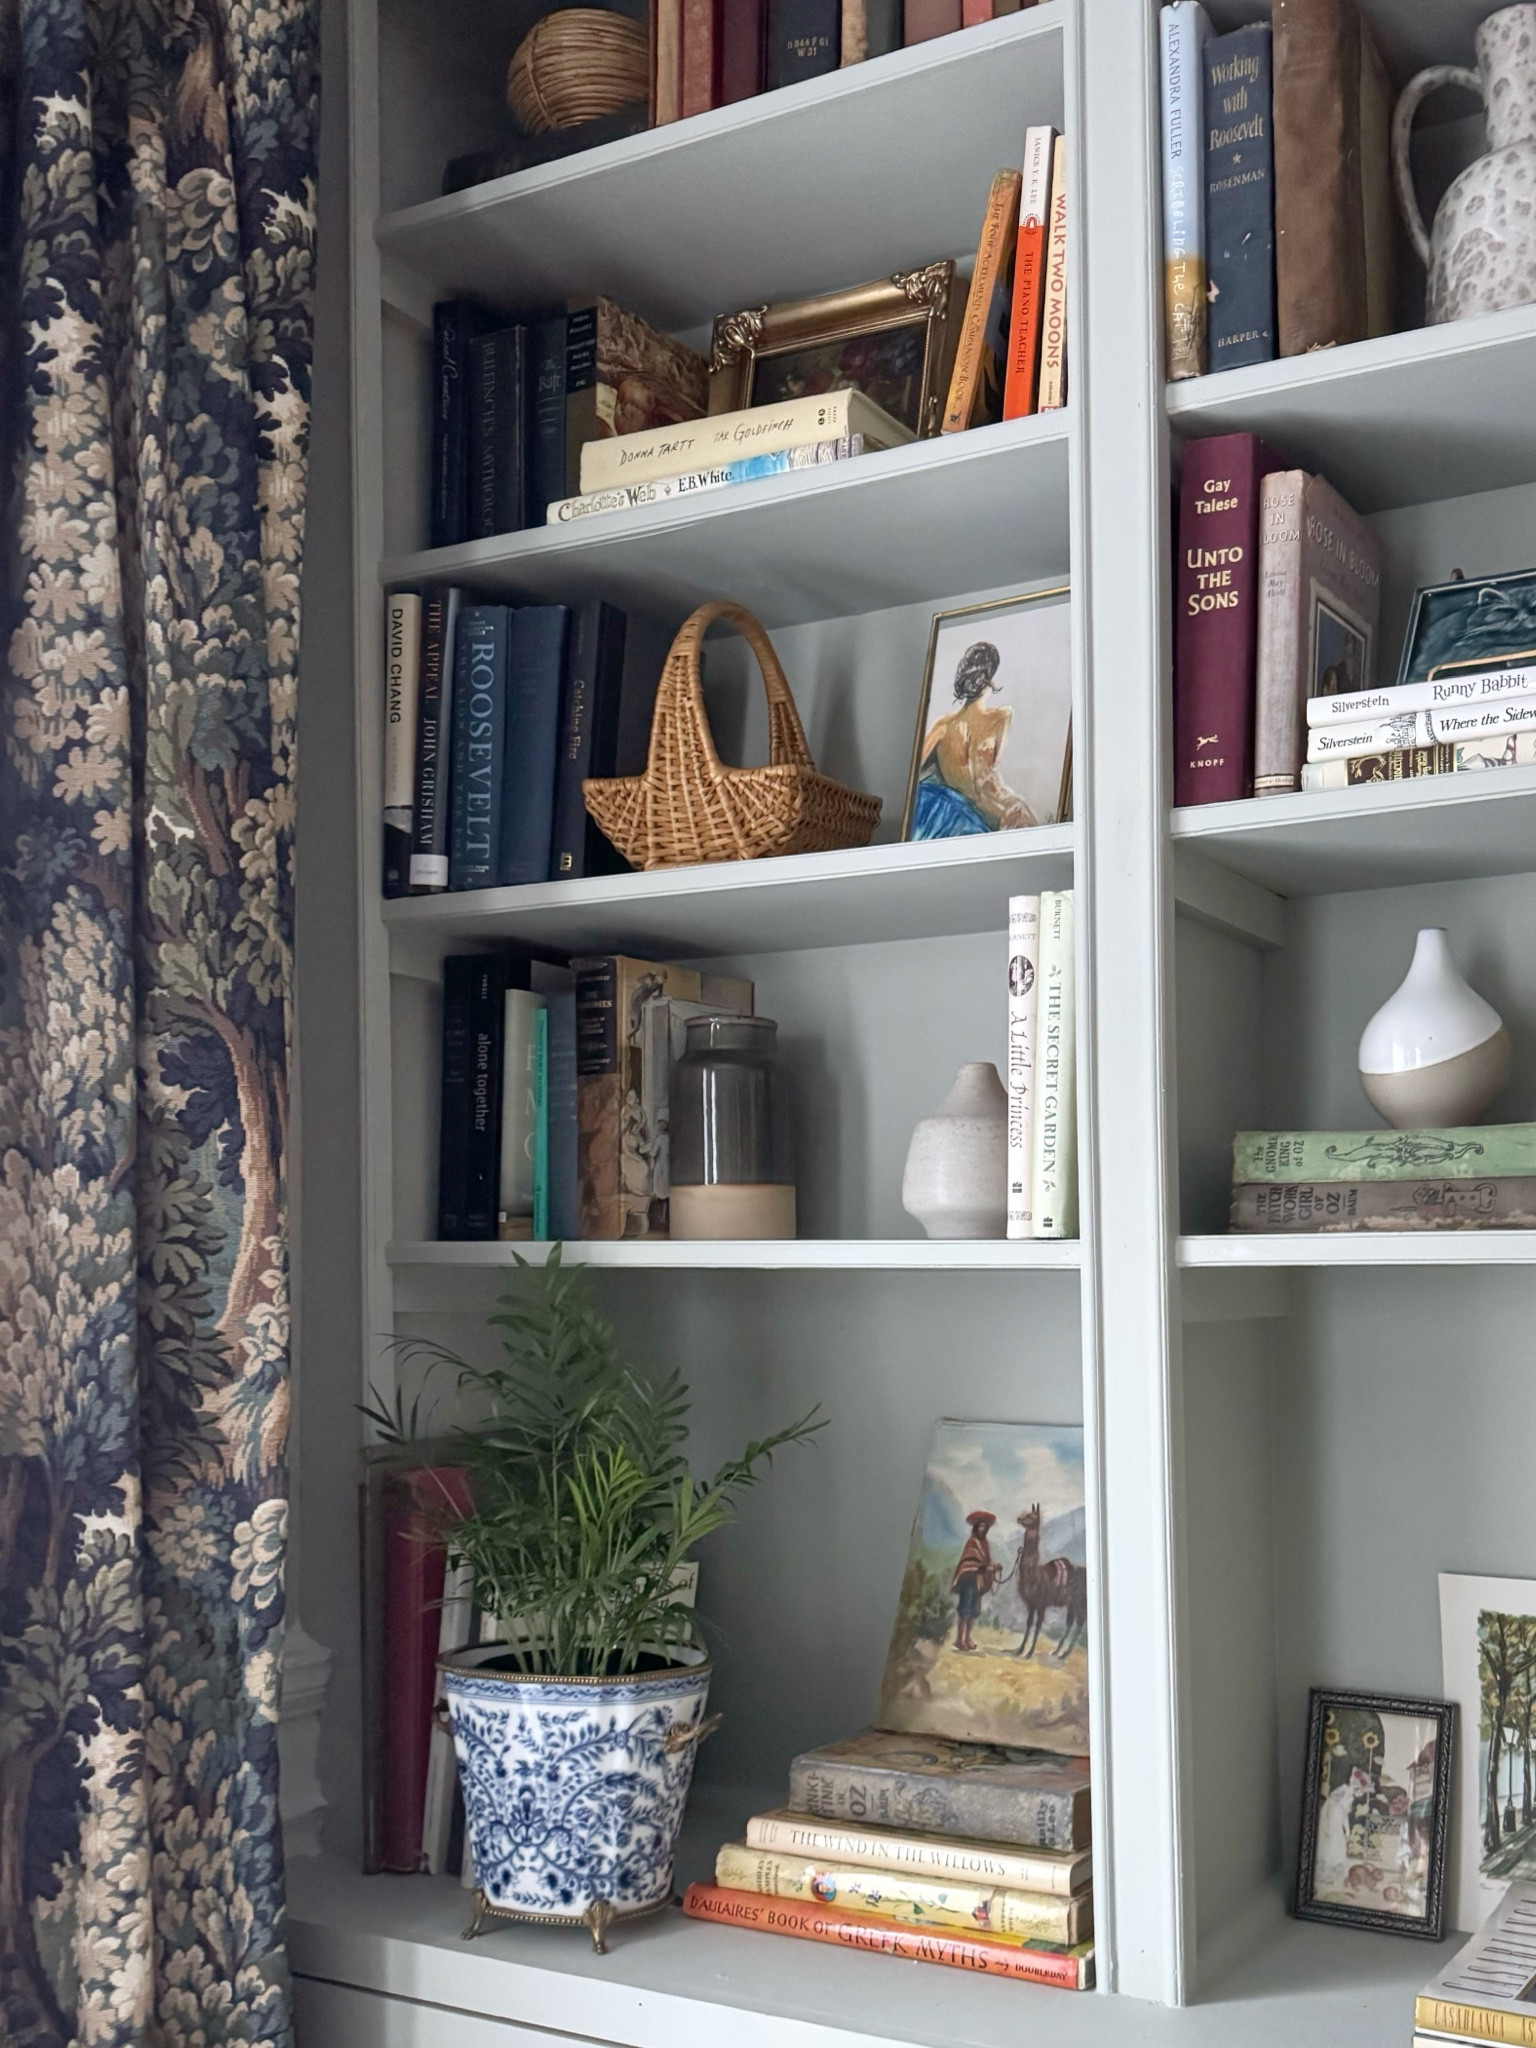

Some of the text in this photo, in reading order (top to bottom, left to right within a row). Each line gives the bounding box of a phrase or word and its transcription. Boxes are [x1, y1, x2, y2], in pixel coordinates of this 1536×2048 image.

[1210, 54, 1260, 87] Working
[1168, 24, 1182, 160] ALEXANDRA FULLER
[1222, 86, 1249, 115] with
[1209, 113, 1264, 152] Roosevelt
[1033, 137, 1042, 166] JANICE
[1209, 168, 1266, 193] ROSENMAN
[1054, 193, 1067, 245] WALK
[1050, 249, 1066, 292] TWO
[1015, 251, 1034, 374] THE PIANO TEACHER
[1046, 298, 1063, 368] MOONS
[1217, 330, 1260, 348] HARPER
[619, 438, 696, 467] DONNA TARTT
[558, 484, 657, 522] Charlotte's Web
[1203, 479, 1231, 494] Gay
[1263, 494, 1295, 510] ROSE
[1194, 496, 1239, 515] Talese
[1270, 513, 1285, 526] IN
[1262, 529, 1300, 545] LOOM
[1186, 546, 1244, 569] UNTO
[1336, 539, 1346, 565] IN
[1350, 553, 1380, 593] BLOOM
[1196, 570, 1232, 590] THE
[1187, 591, 1239, 616] SONS
[389, 608, 403, 724] DAVID CHANG
[1331, 673, 1529, 713] Silverstein Runny Babbit
[419, 600, 442, 845] THE APPEAL JOHN GRISHAM
[1317, 732, 1373, 751] Silverstein
[1440, 717, 1478, 732] Where
[1480, 713, 1500, 727] the
[466, 641, 496, 859] ROOSEVELT
[569, 736, 582, 760] Fire
[1189, 758, 1225, 769] KNOPF
[1053, 899, 1062, 941] BURNETT
[474, 1033, 491, 1132] alone together
[1009, 1011, 1032, 1149] A Little Princess
[1042, 982, 1062, 1174] THE SECRET GARDEN
[1265, 1134, 1279, 1173] GNOME
[1279, 1140, 1291, 1167] KING
[1293, 1140, 1304, 1154] OZ
[1281, 1185, 1299, 1223] WORK
[1298, 1187, 1314, 1220] GIRL
[1314, 1195, 1325, 1211] OF
[1326, 1191, 1340, 1215] OZ
[849, 1784, 867, 1818] OZ
[790, 1828, 821, 1847] THE
[823, 1833, 867, 1854] WIND
[870, 1840, 888, 1857] IN
[895, 1845, 926, 1863] THE
[930, 1851, 1005, 1876] WILLOWS
[767, 1910, 814, 1932] BOOK
[916, 1937, 989, 1969] MYTHS
[1015, 1963, 1068, 1981] DOUBLEDAY
[1434, 2001, 1505, 2038] CASABLANCA
